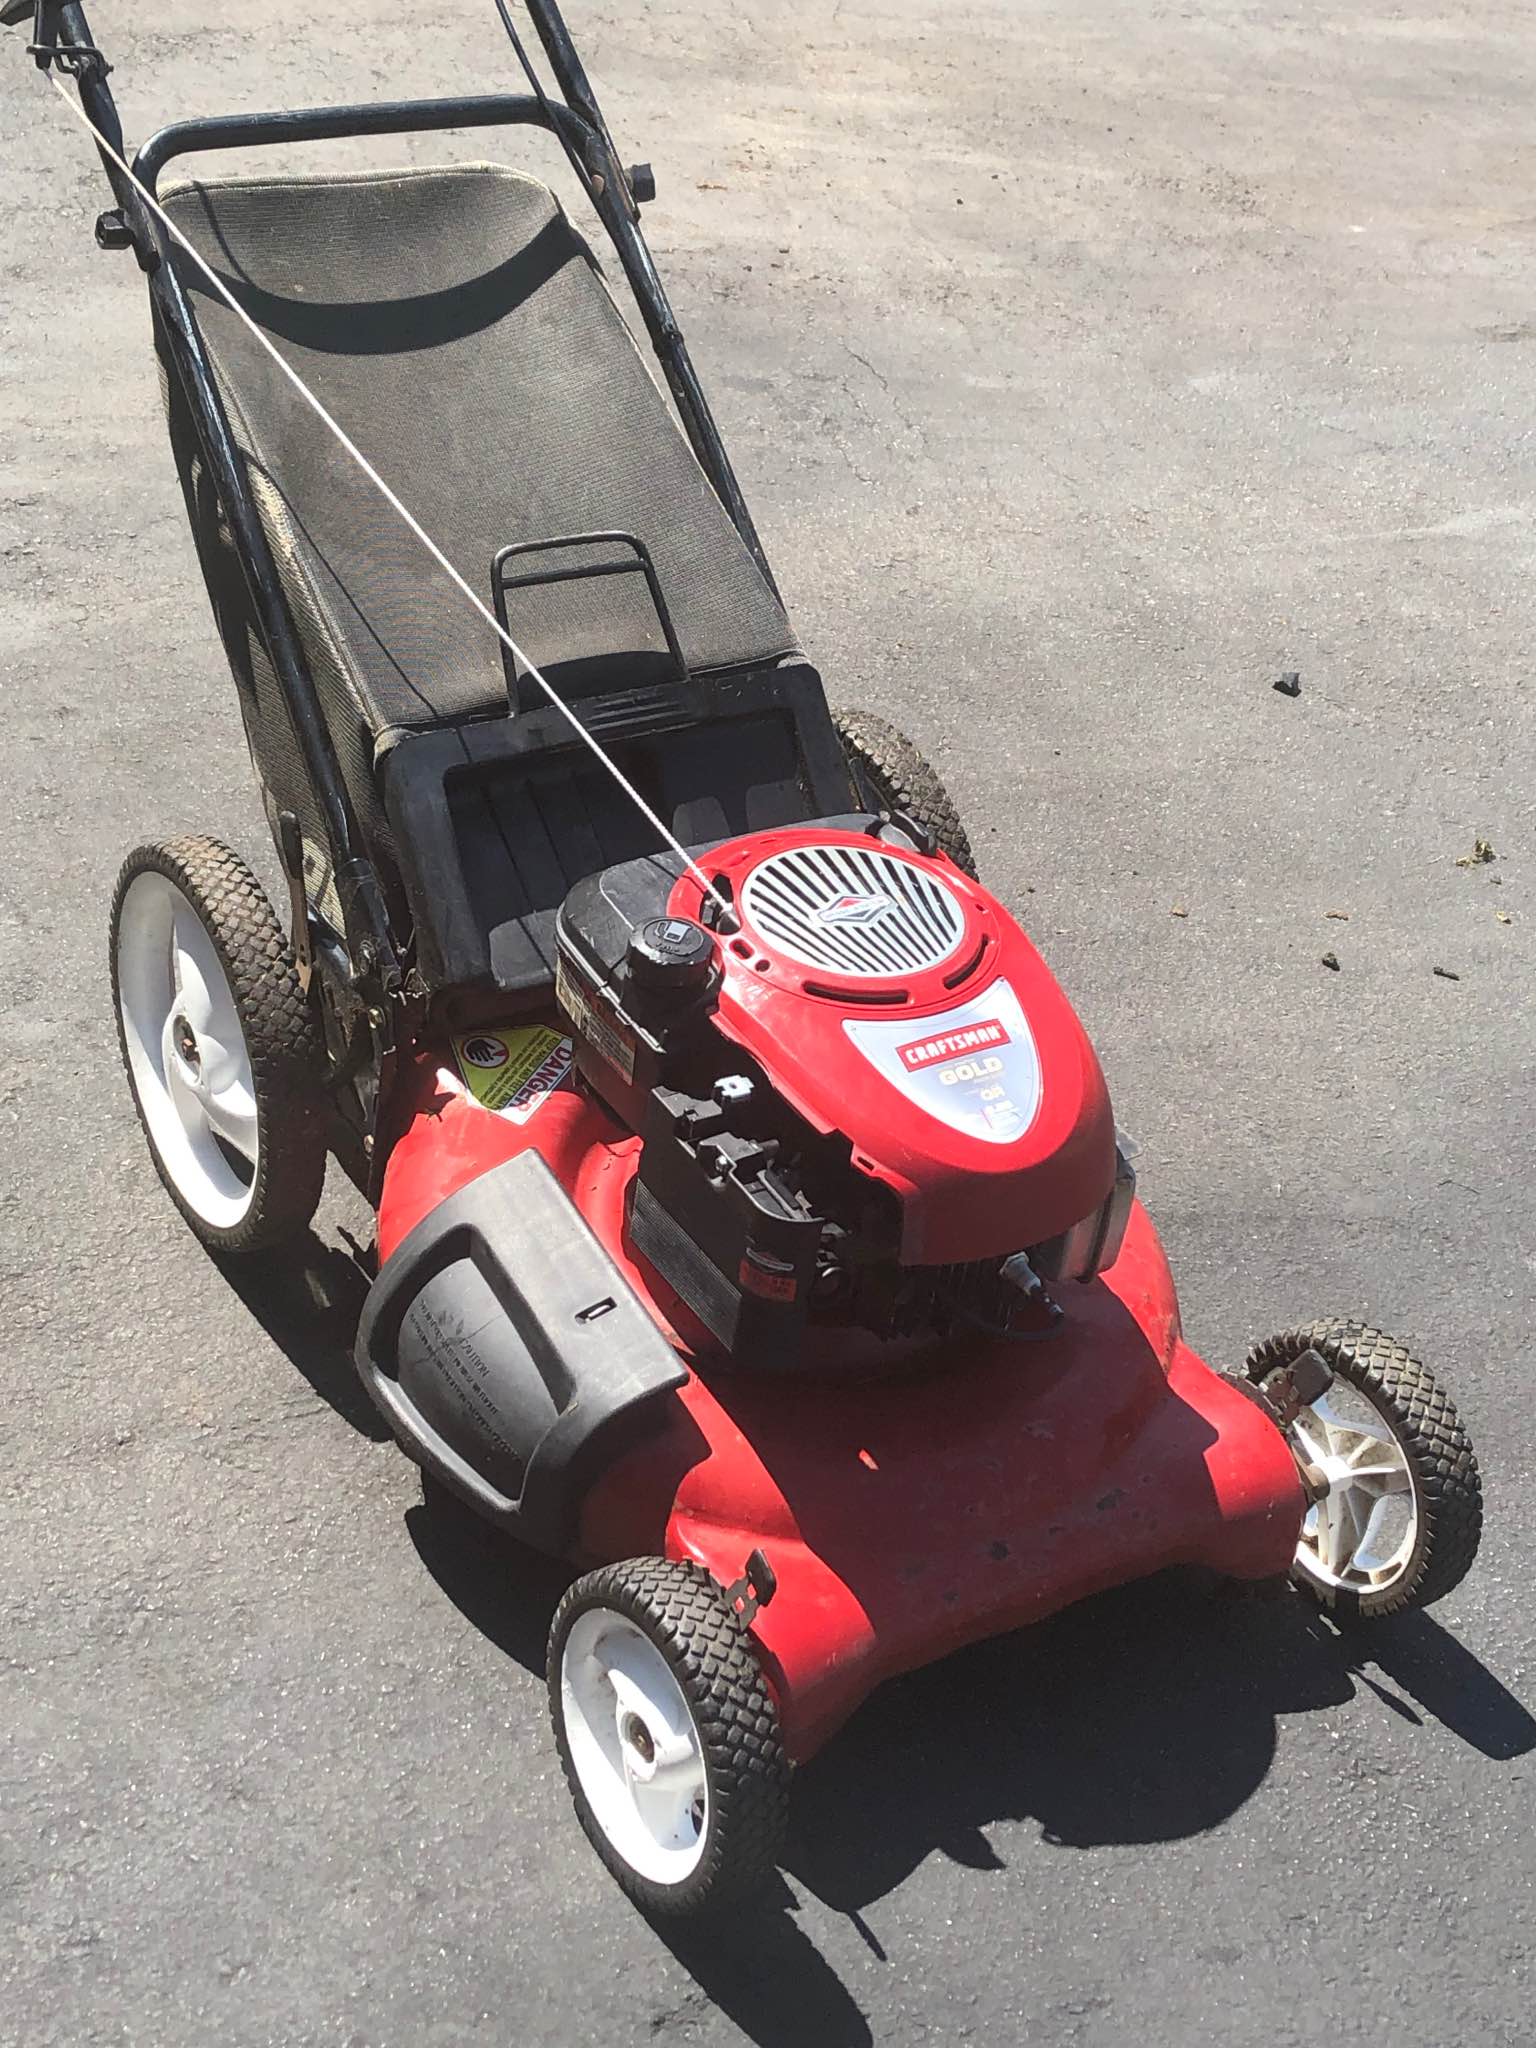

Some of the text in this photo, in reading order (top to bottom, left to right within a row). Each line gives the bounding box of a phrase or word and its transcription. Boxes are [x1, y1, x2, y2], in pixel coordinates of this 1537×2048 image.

[905, 1025, 1001, 1064] CRAFTSMAN
[509, 1045, 573, 1112] DANGER
[939, 1056, 1003, 1085] GOLD
